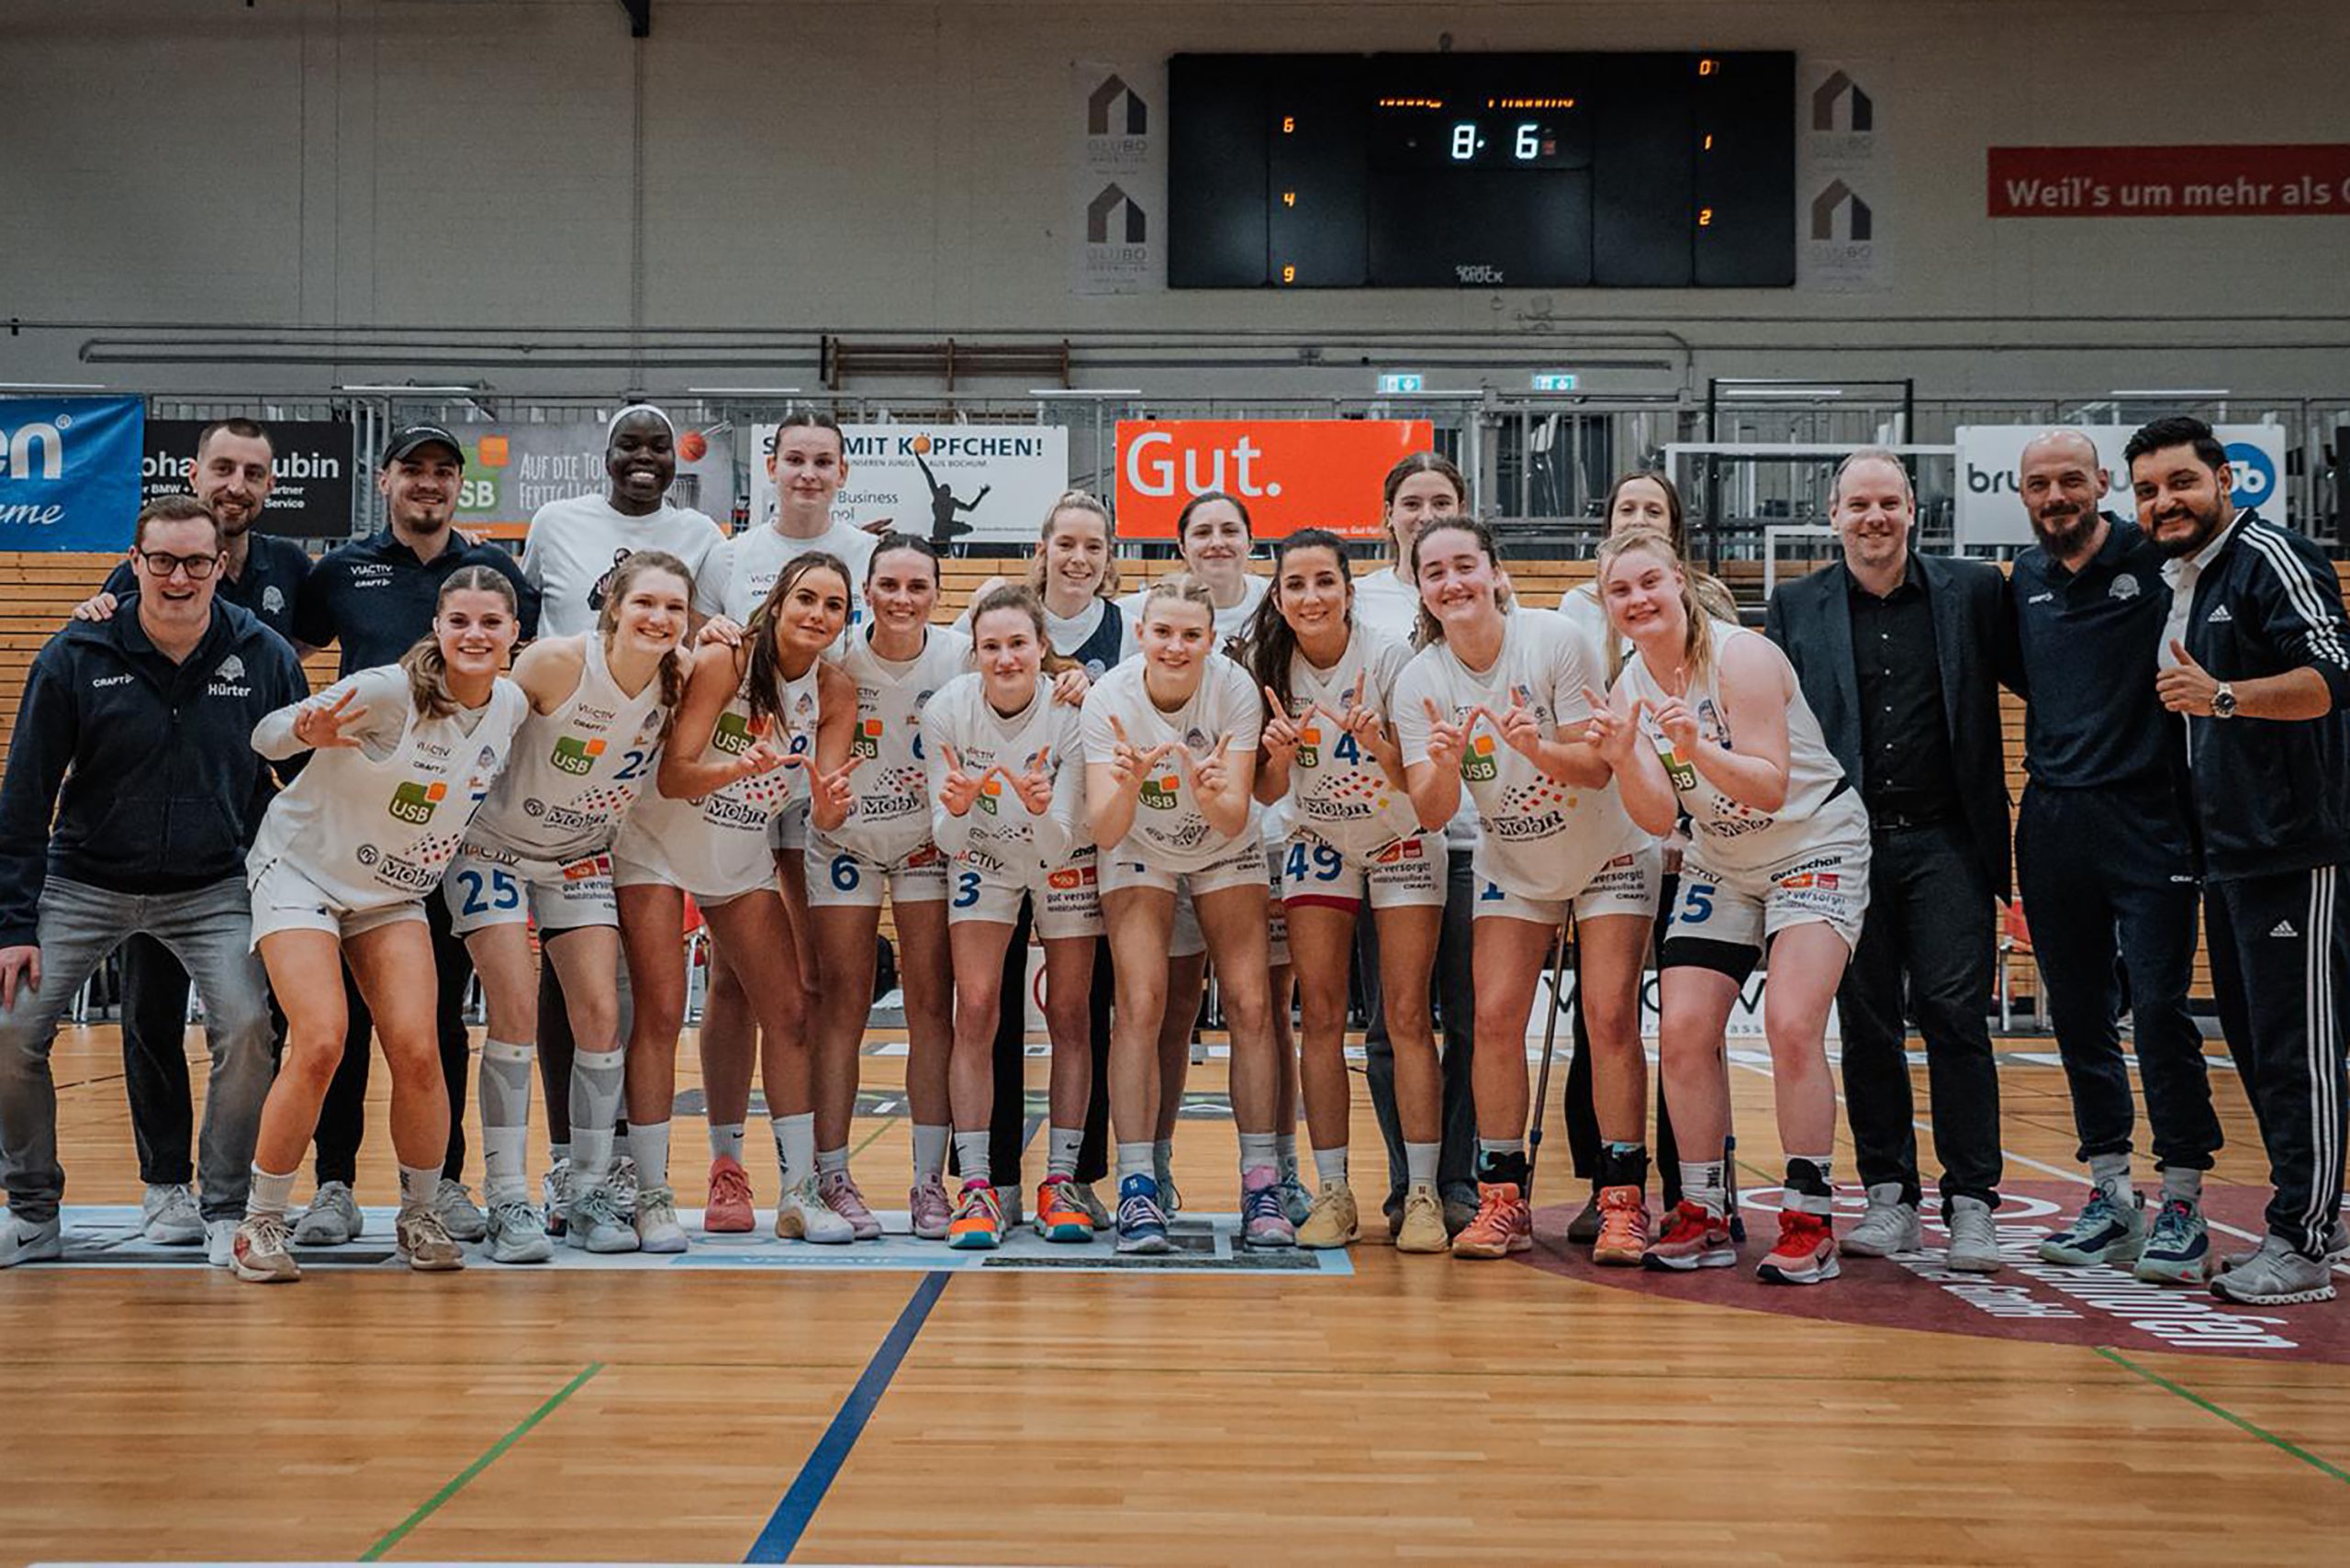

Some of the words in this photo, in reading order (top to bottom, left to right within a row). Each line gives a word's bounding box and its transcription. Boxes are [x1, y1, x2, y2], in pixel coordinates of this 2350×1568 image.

[1283, 117, 1295, 133] 6
[1452, 125, 1475, 160] 8
[1516, 125, 1539, 160] 6
[1284, 192, 1295, 207] 4
[2007, 177, 2110, 207] Weil's
[2120, 184, 2173, 206] um
[2184, 175, 2273, 206] mehr
[2282, 175, 2332, 205] als
[1699, 209, 1712, 225] 2
[1284, 265, 1295, 283] 9
[845, 438, 888, 455] MIT
[1126, 432, 1281, 497] Gut.
[151, 485, 180, 495] BMW
[837, 491, 899, 504] Business
[93, 677, 125, 688] CRAFT
[207, 683, 252, 697] Hürter
[851, 741, 877, 757] SB
[553, 752, 590, 774] USB
[391, 799, 431, 823] USB
[1286, 842, 1343, 881] 49
[832, 854, 860, 891] 6
[457, 868, 520, 916] 25
[954, 872, 981, 908] 3
